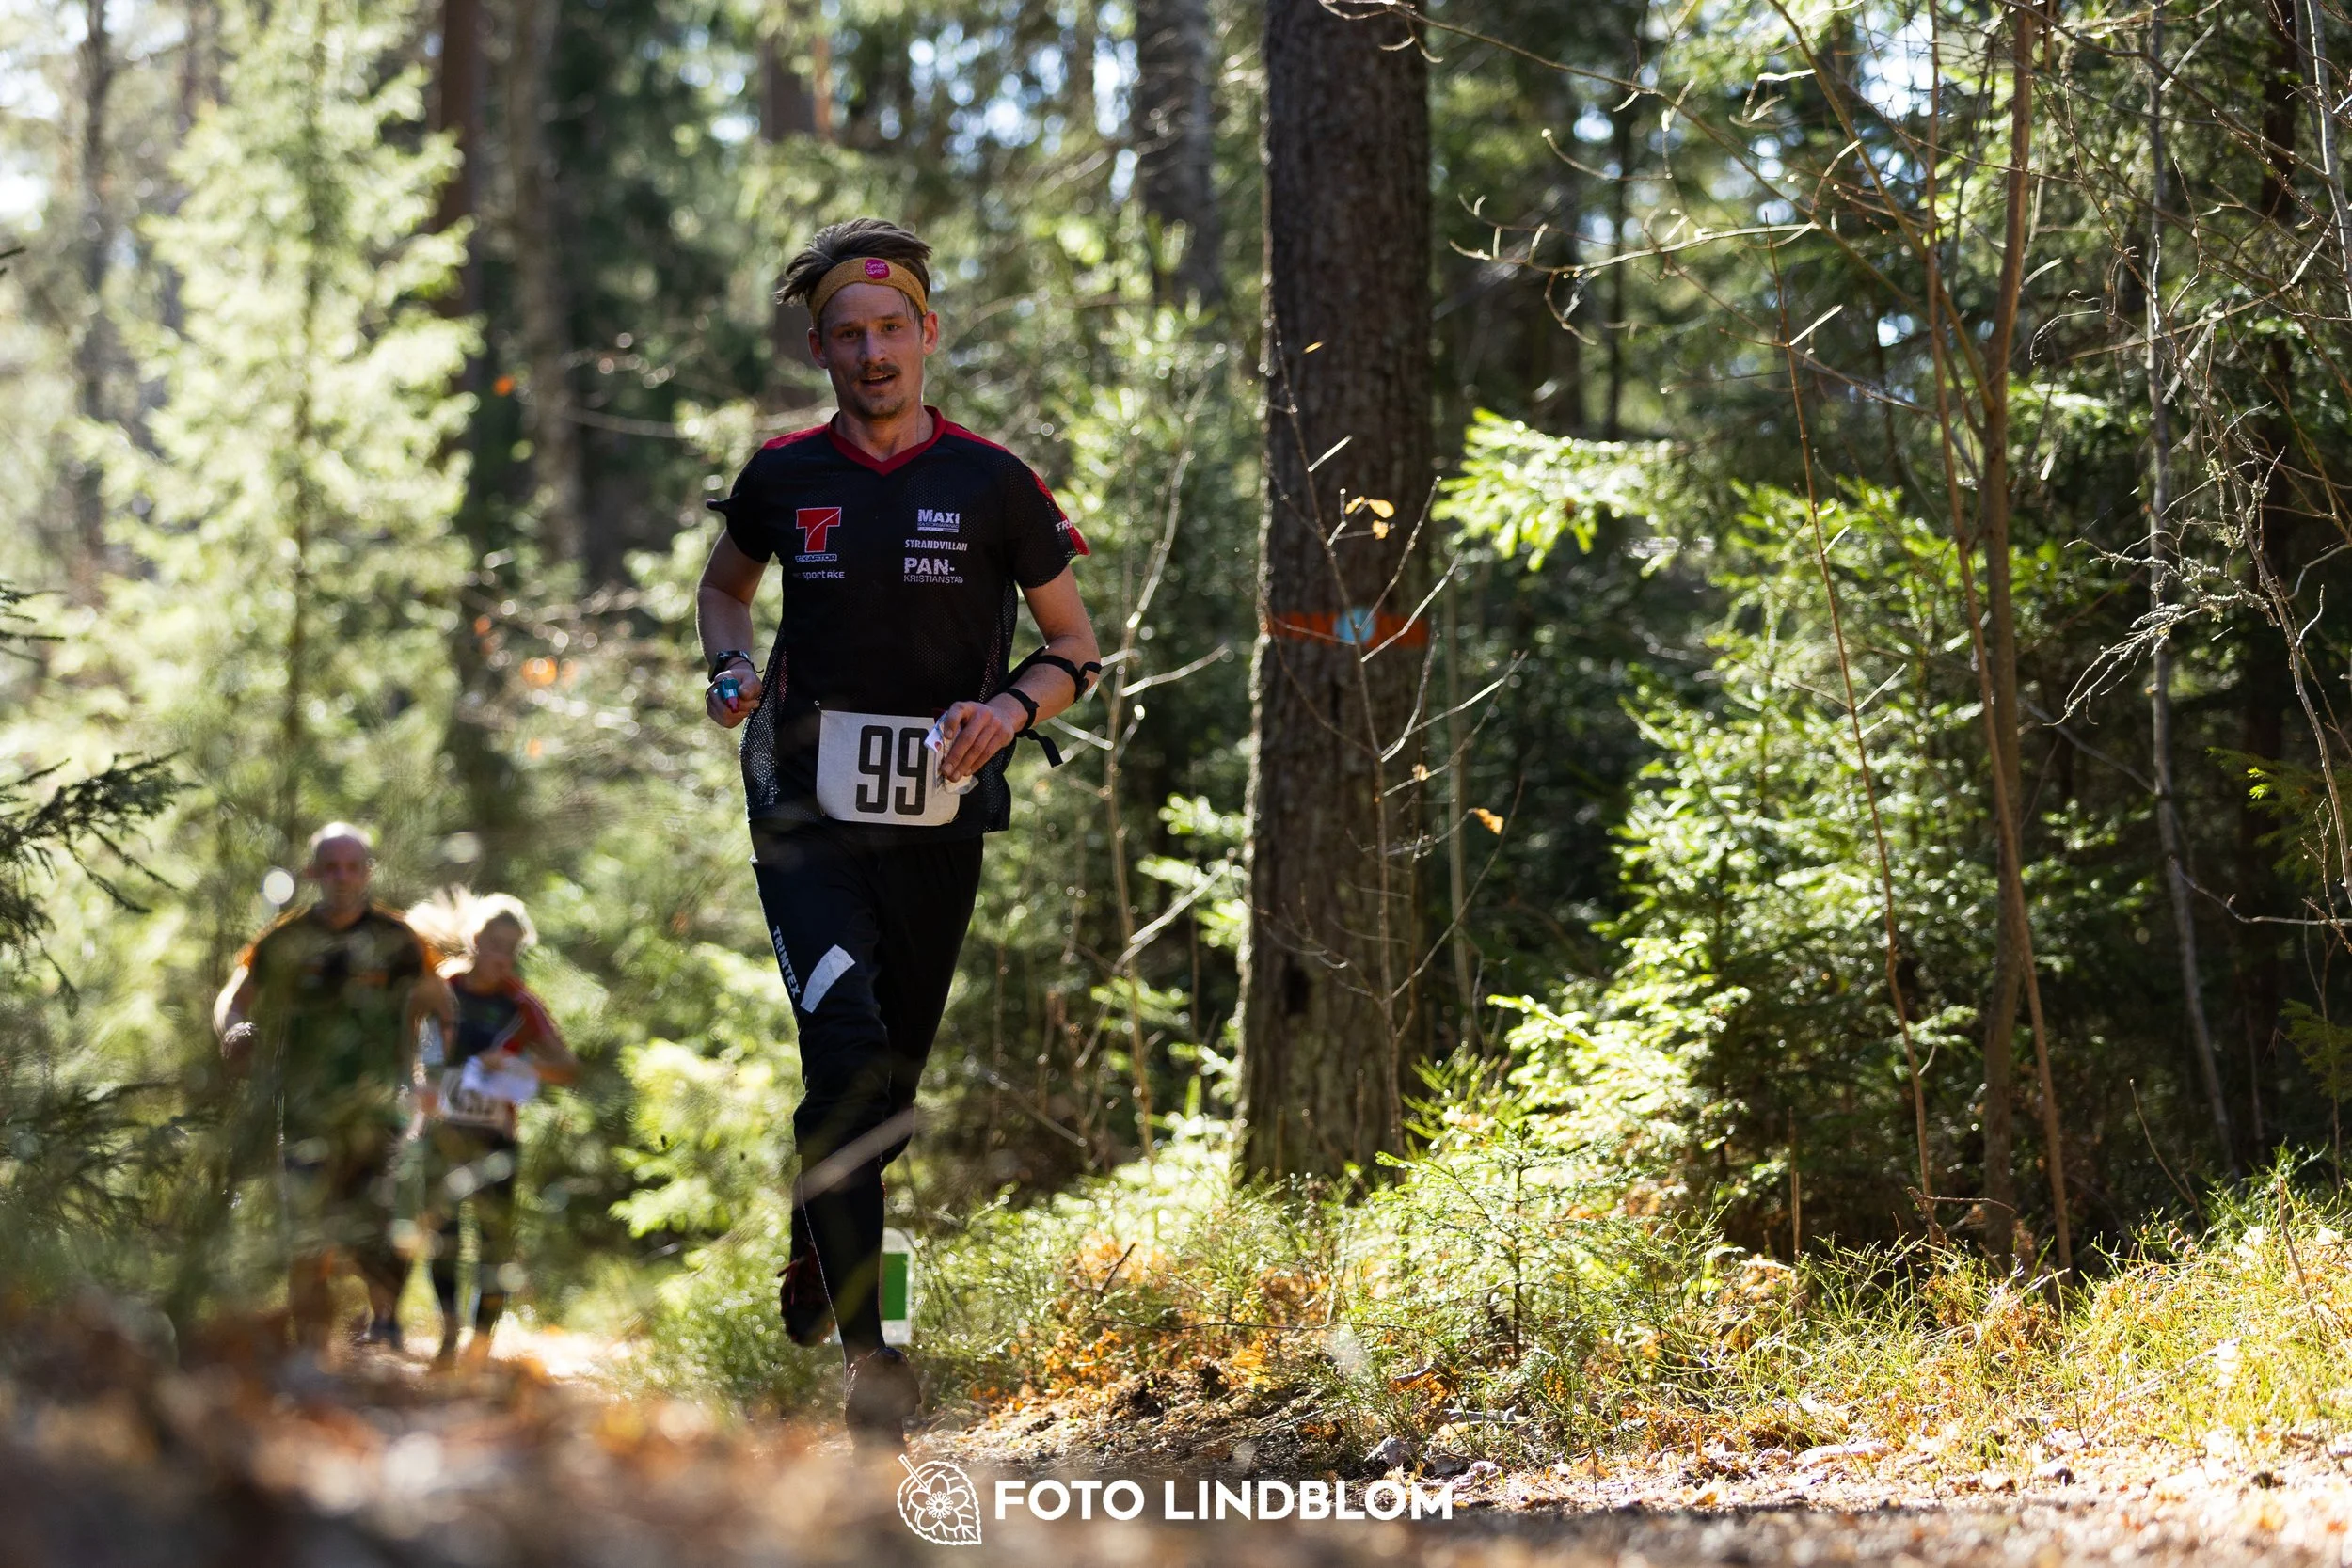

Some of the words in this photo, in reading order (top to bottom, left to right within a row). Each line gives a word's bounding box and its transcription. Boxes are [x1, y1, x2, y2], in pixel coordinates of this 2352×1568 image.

[917, 509, 961, 524] MAXI
[905, 539, 968, 552] STRANDVILLAN
[903, 574, 964, 584] KRISTIANSTAD
[855, 724, 929, 816] 99
[773, 925, 801, 1000] TRIMTEX
